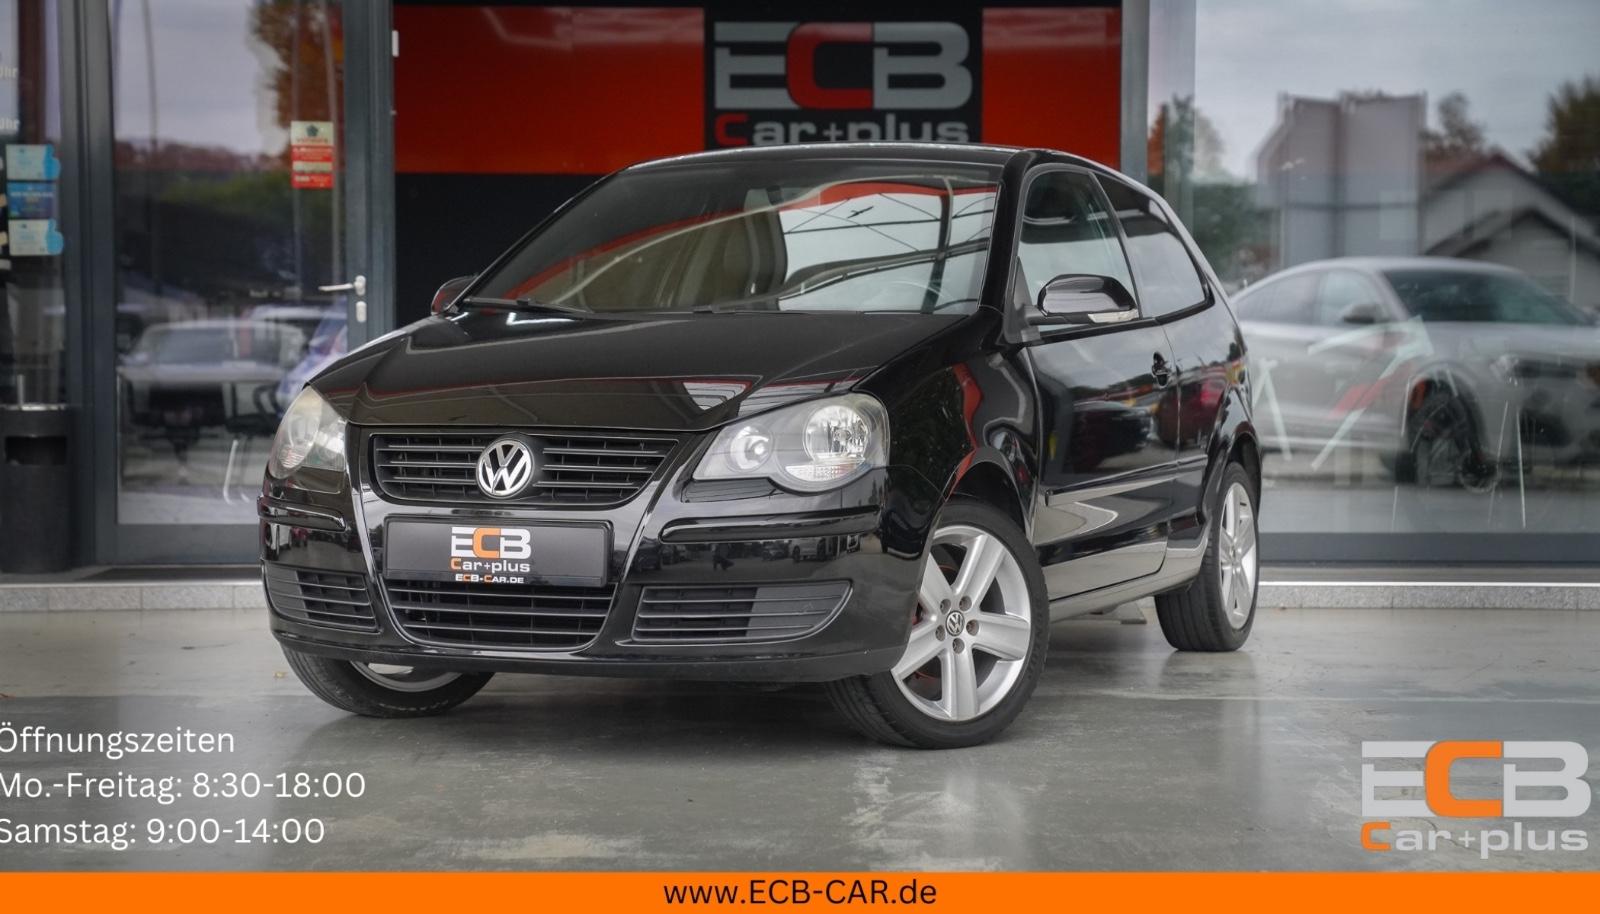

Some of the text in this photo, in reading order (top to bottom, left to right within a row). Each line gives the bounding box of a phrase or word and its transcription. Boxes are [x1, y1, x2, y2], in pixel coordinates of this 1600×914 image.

[714, 21, 973, 110] ECB
[714, 113, 970, 147] Car+plus
[451, 527, 531, 559] ECB
[451, 558, 531, 574] Car+plus
